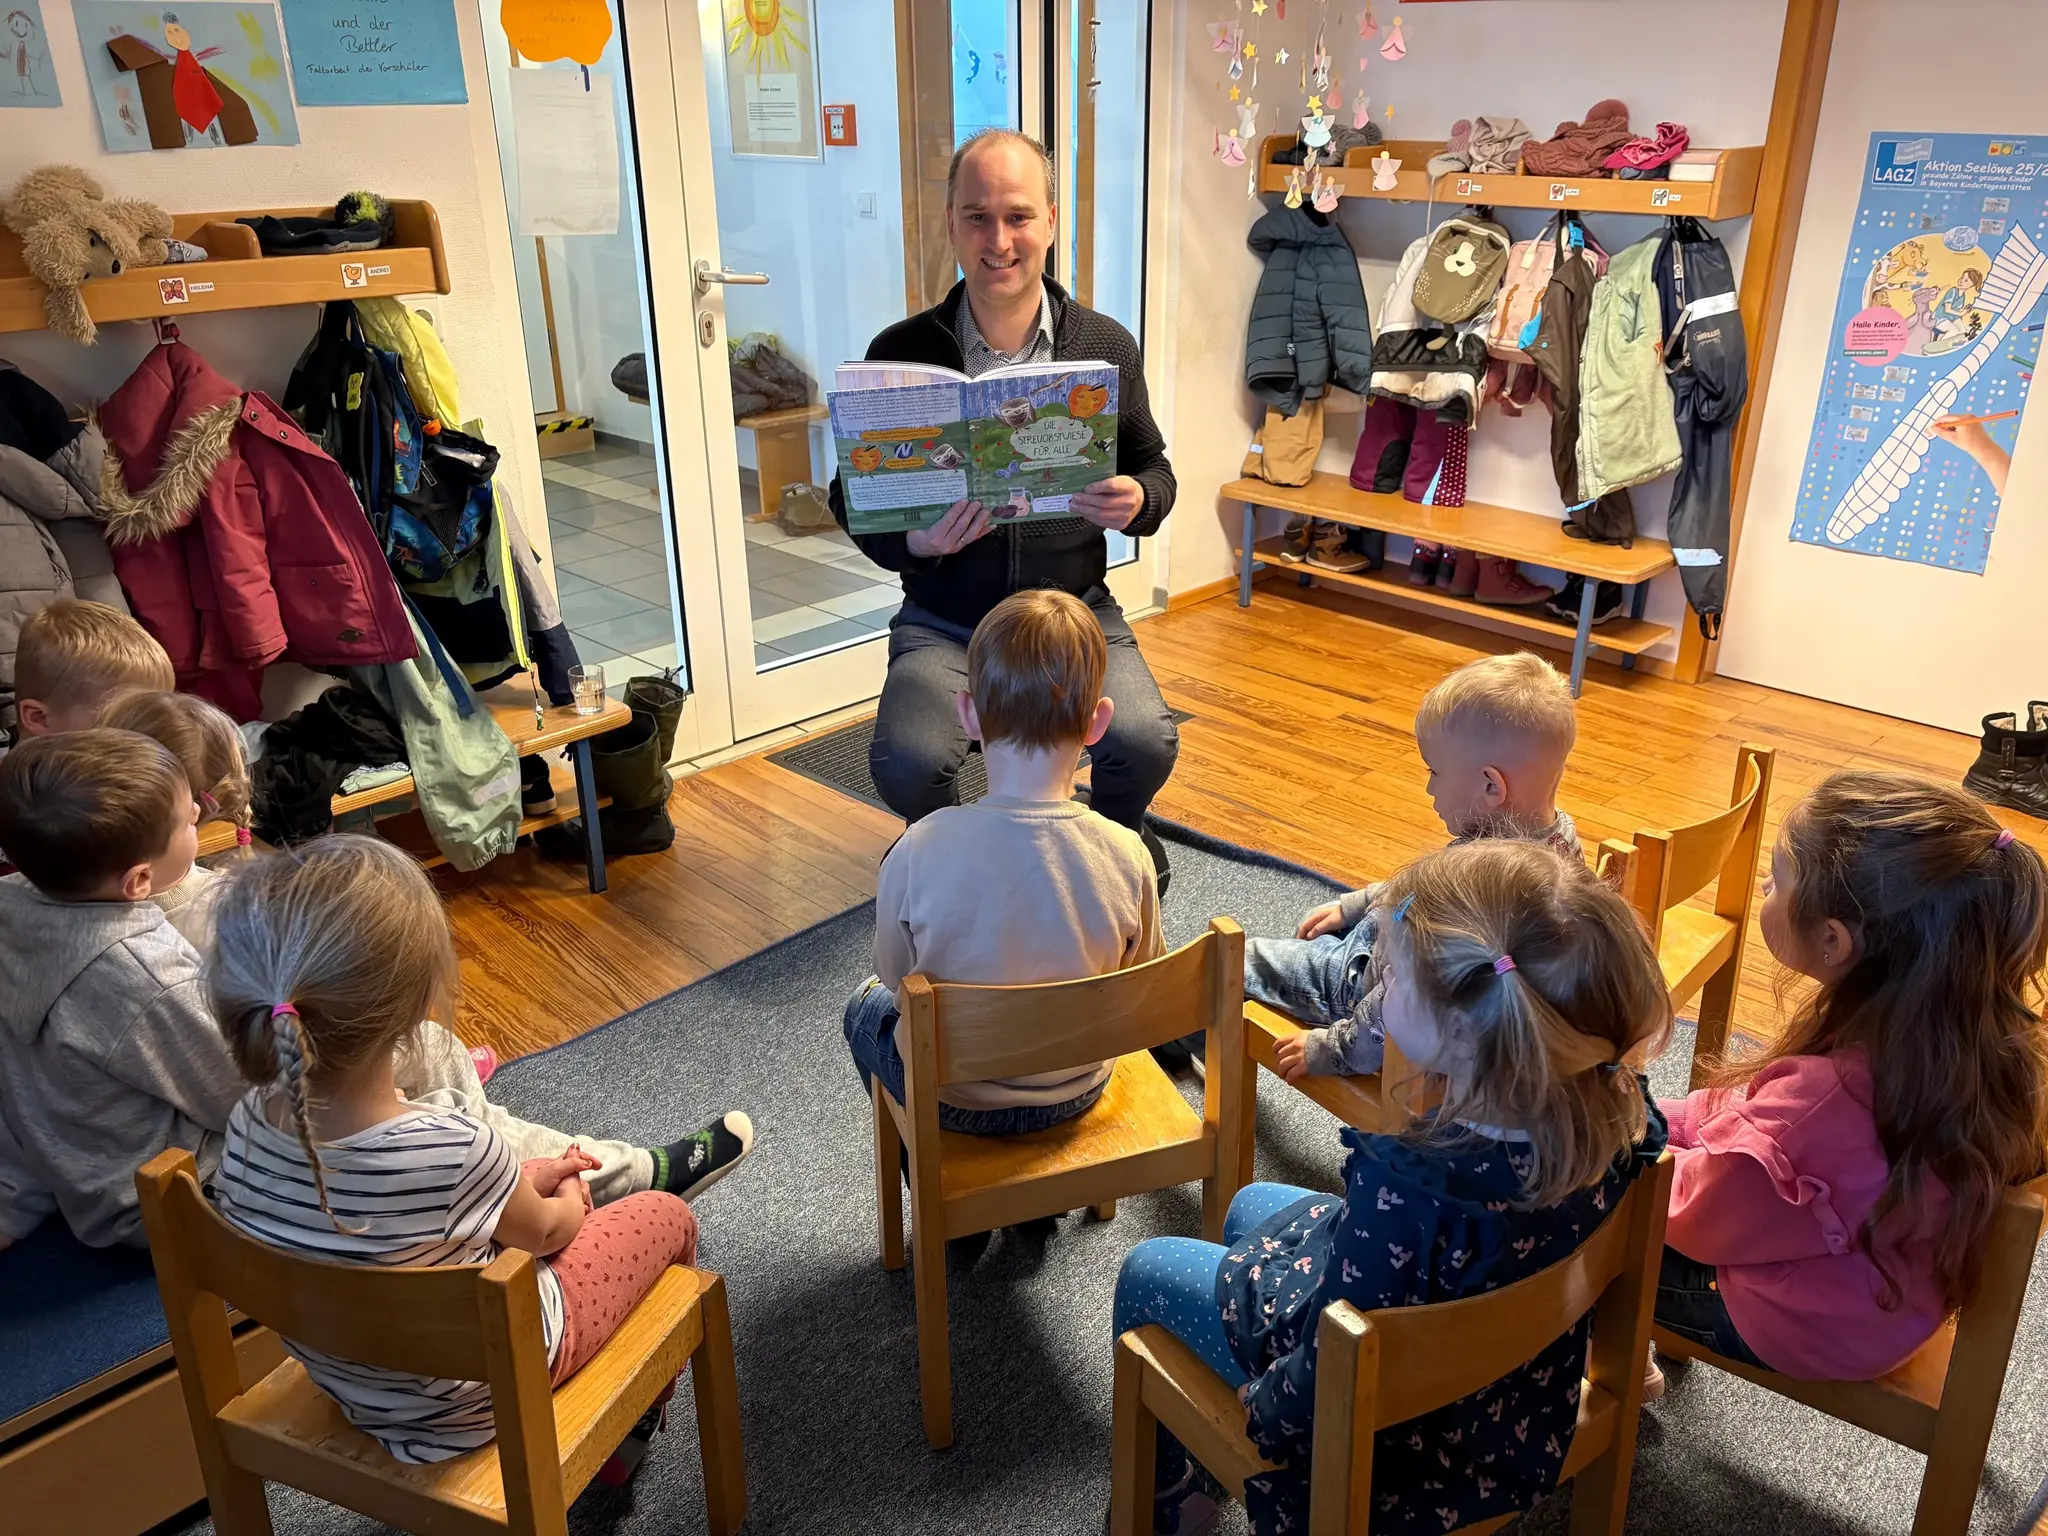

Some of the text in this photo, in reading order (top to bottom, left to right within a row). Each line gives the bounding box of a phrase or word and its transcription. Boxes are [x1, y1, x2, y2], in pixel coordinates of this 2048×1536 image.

[332, 14, 395, 31] und der
[340, 35, 399, 54] Bettler
[306, 61, 429, 75] Faltarbeit der Vorschüler
[1924, 160, 1962, 172] Aktion
[1964, 162, 2013, 175] Seelöwe
[1874, 167, 1915, 182] LAGZ
[1921, 172, 1949, 180] gesunde
[1950, 172, 1973, 180] Zähne
[1978, 175, 2007, 183] gesunde
[2008, 175, 2034, 183] Kinder
[1929, 180, 1958, 189] Bayerns
[1960, 181, 2031, 191] Kindertagesstätten
[370, 267, 390, 275] ANDREI
[190, 283, 214, 291] HELENA
[1043, 421, 1057, 430] DIE
[1018, 430, 1087, 445] STREUOBSTWIESE
[1033, 444, 1072, 456] FÜR ALLE
